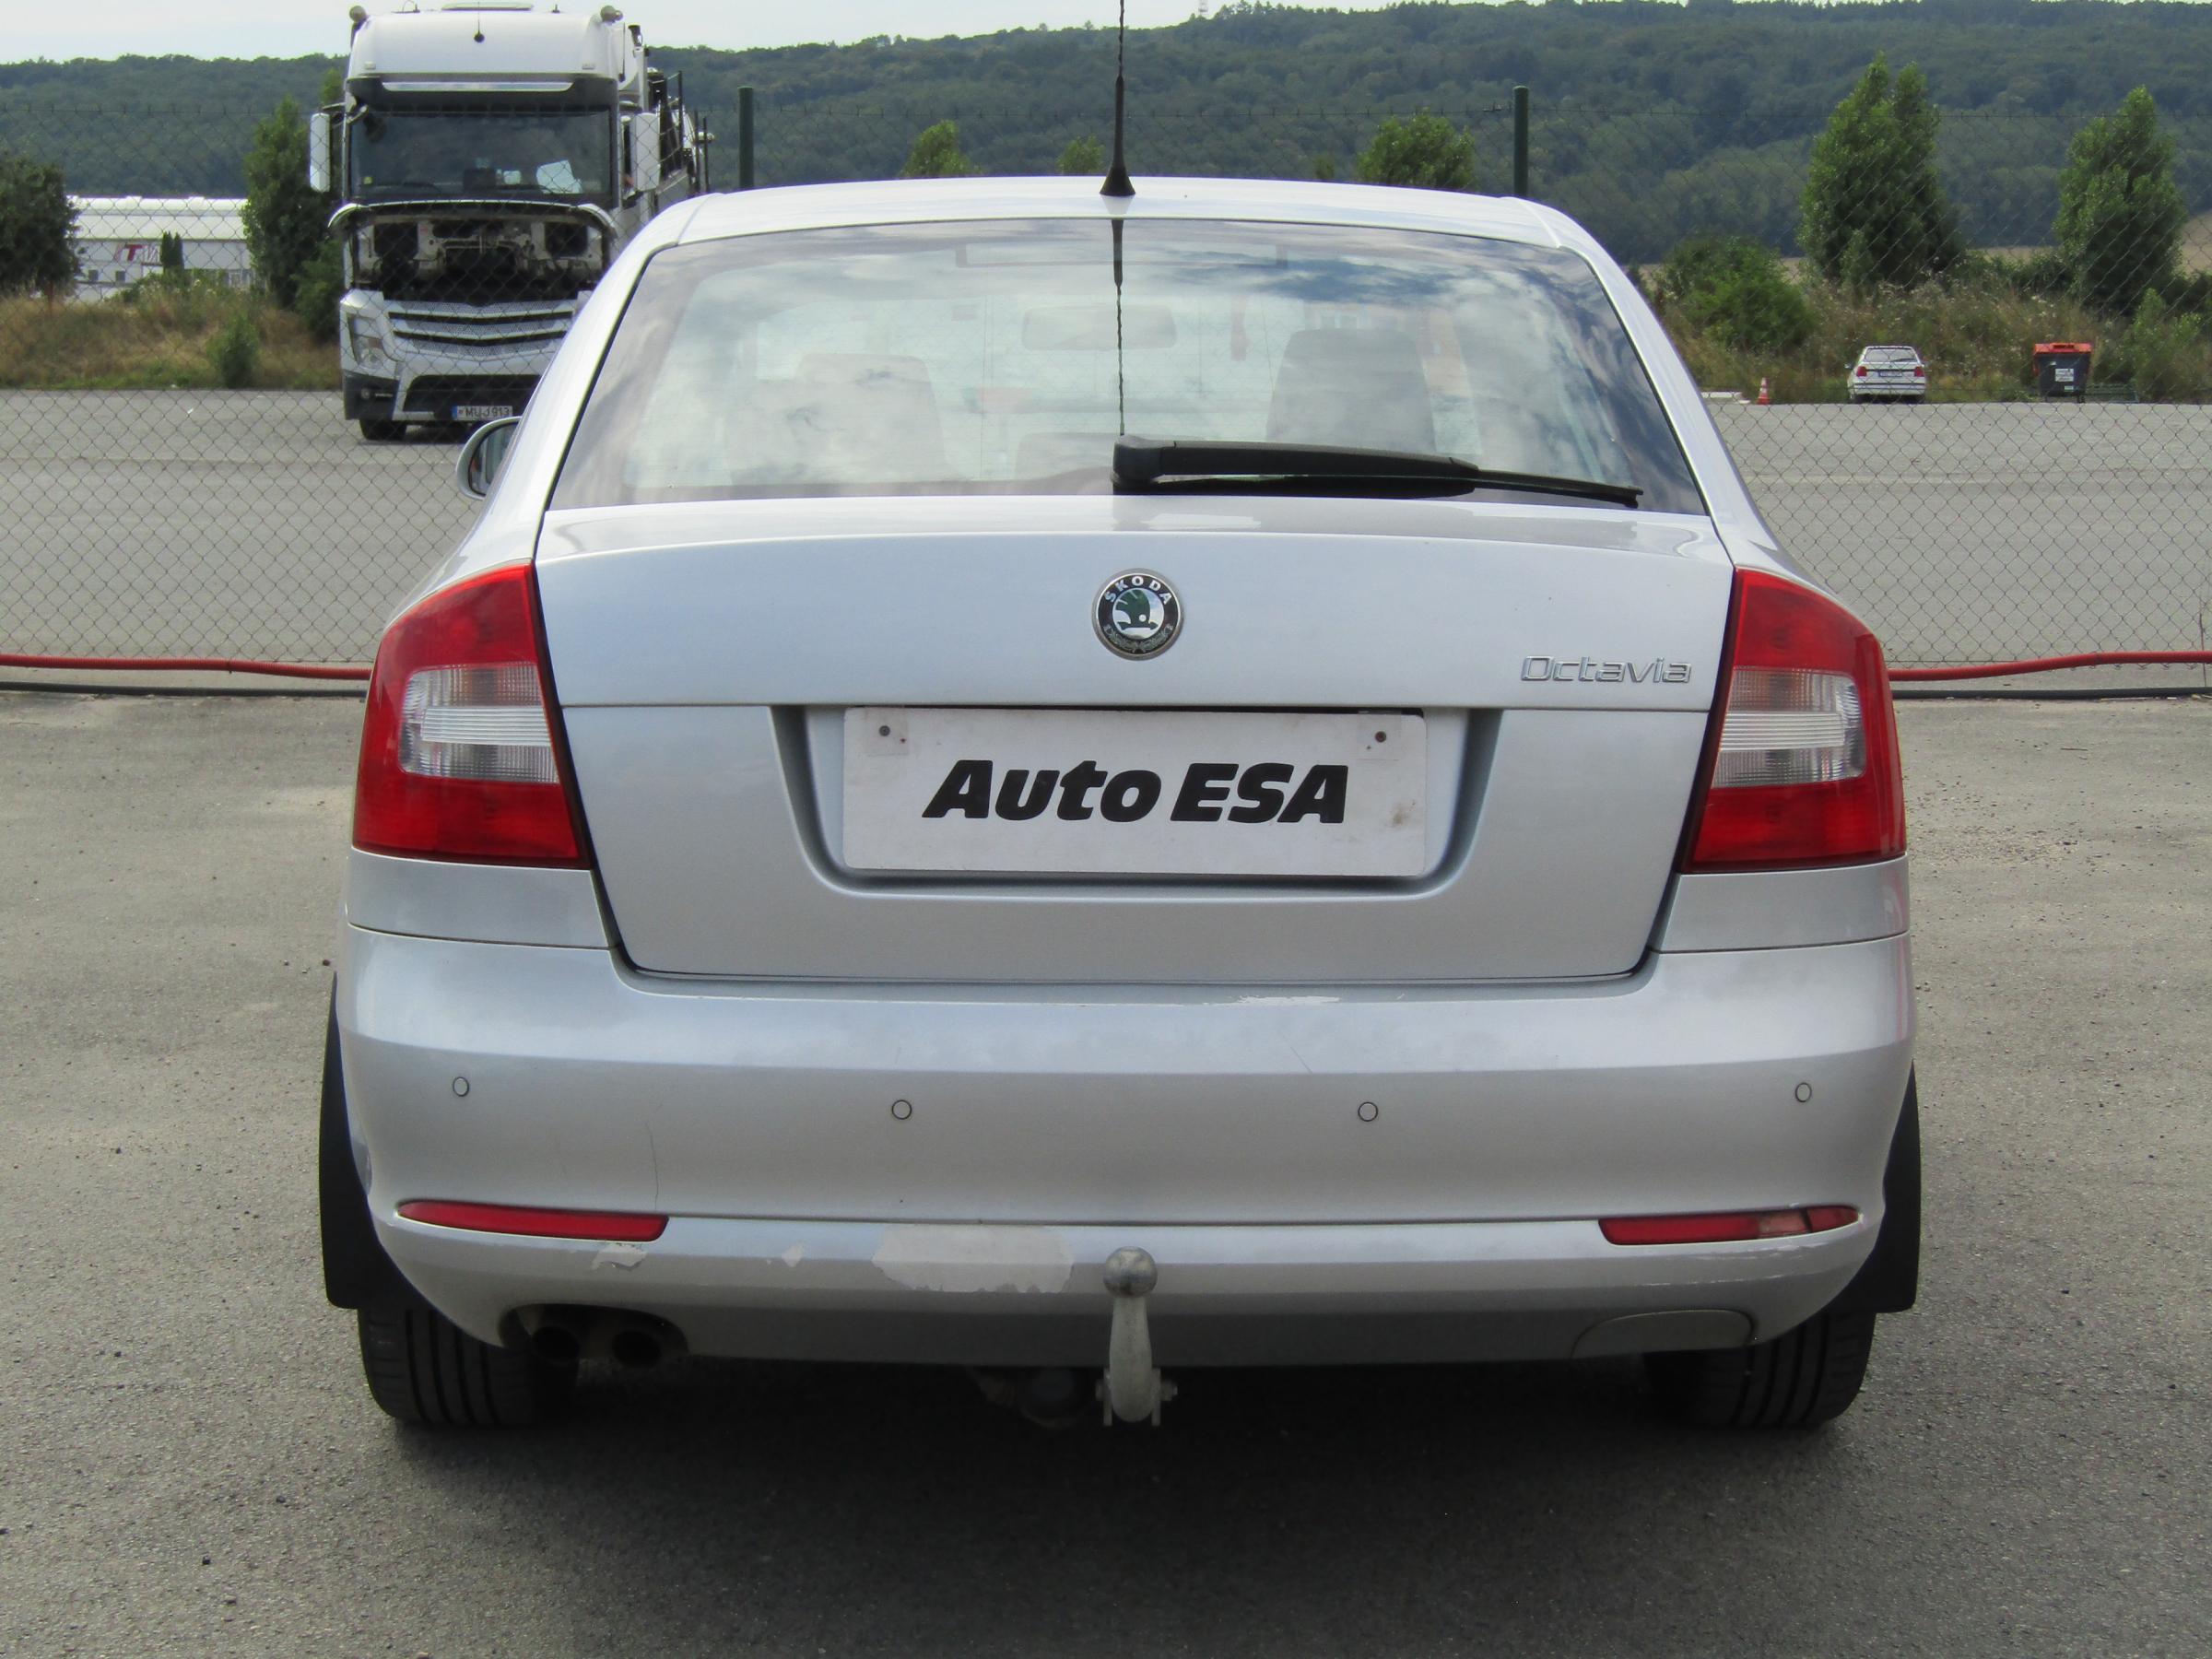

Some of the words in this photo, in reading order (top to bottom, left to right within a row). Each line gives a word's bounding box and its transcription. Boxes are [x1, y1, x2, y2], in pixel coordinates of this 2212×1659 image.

[1521, 655, 1692, 684] Octavia
[921, 759, 1162, 823] Auto
[1170, 762, 1348, 824] ESA
